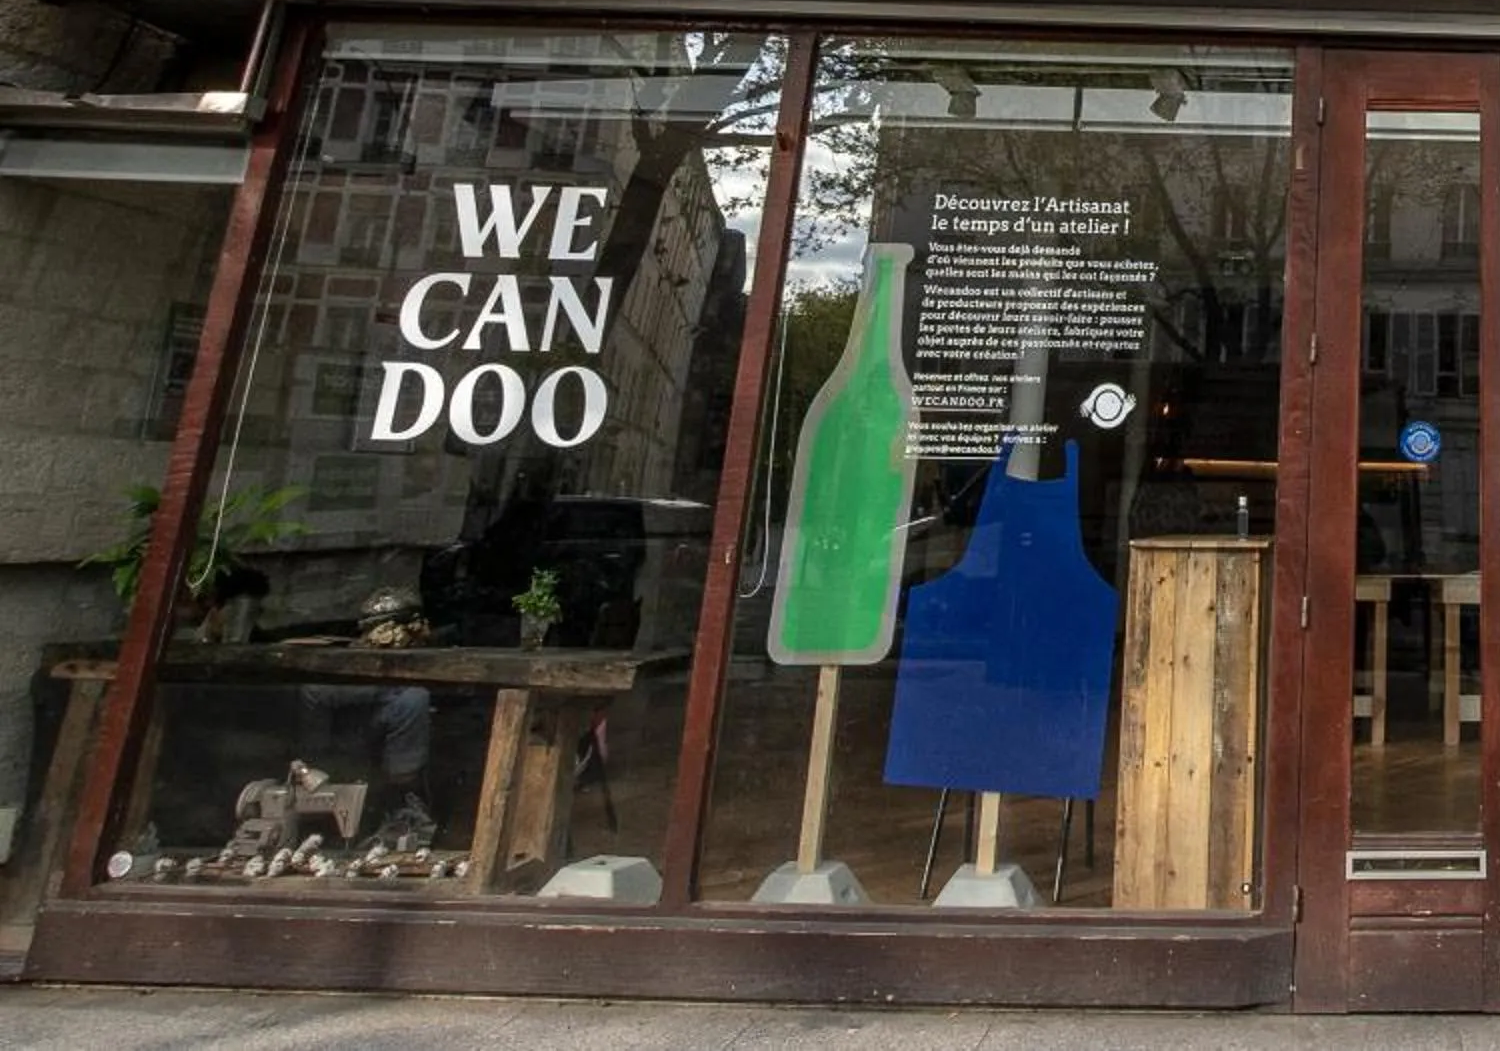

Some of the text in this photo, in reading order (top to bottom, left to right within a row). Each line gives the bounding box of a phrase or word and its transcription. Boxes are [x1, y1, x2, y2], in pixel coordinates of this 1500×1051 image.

[934, 194, 1130, 214] Découvrez l'Artisanat
[453, 184, 608, 261] WE
[931, 215, 948, 230] le
[953, 217, 1008, 235] temps
[1014, 216, 1055, 233] d'un
[1059, 218, 1119, 234] atelier
[928, 242, 954, 252] Vous
[952, 256, 1000, 265] viennent
[1002, 256, 1016, 266] les
[1018, 257, 1063, 268] produits
[1066, 260, 1084, 269] que
[1087, 260, 1112, 269] vous
[926, 267, 964, 279] quelles
[966, 269, 988, 277] sont
[991, 268, 1006, 277] les
[1008, 269, 1040, 278] mains
[1042, 271, 1060, 281] qui
[1062, 271, 1077, 280] les
[1079, 272, 1097, 280] ont
[924, 284, 981, 295] Wecandoo
[1018, 287, 1062, 298] collectif
[1116, 290, 1127, 300] et
[922, 297, 935, 308] de
[937, 298, 1002, 309] producteurs
[1004, 300, 1058, 311] proposant
[1060, 301, 1078, 310] des
[400, 272, 613, 353] CAN
[920, 312, 945, 321] pour
[1002, 312, 1030, 321] leurs
[919, 323, 934, 332] les
[937, 325, 970, 335] portes
[972, 324, 986, 333] de
[988, 325, 1016, 334] leurs
[1116, 328, 1144, 338] votre
[917, 336, 944, 346] objet
[985, 337, 998, 346] de
[1001, 338, 1018, 347] ces
[916, 349, 940, 358] avec
[943, 350, 970, 359] votre
[954, 374, 962, 382] et
[958, 385, 985, 393] France
[370, 361, 609, 448] DOO
[911, 396, 1005, 407] WECANDOO.FR
